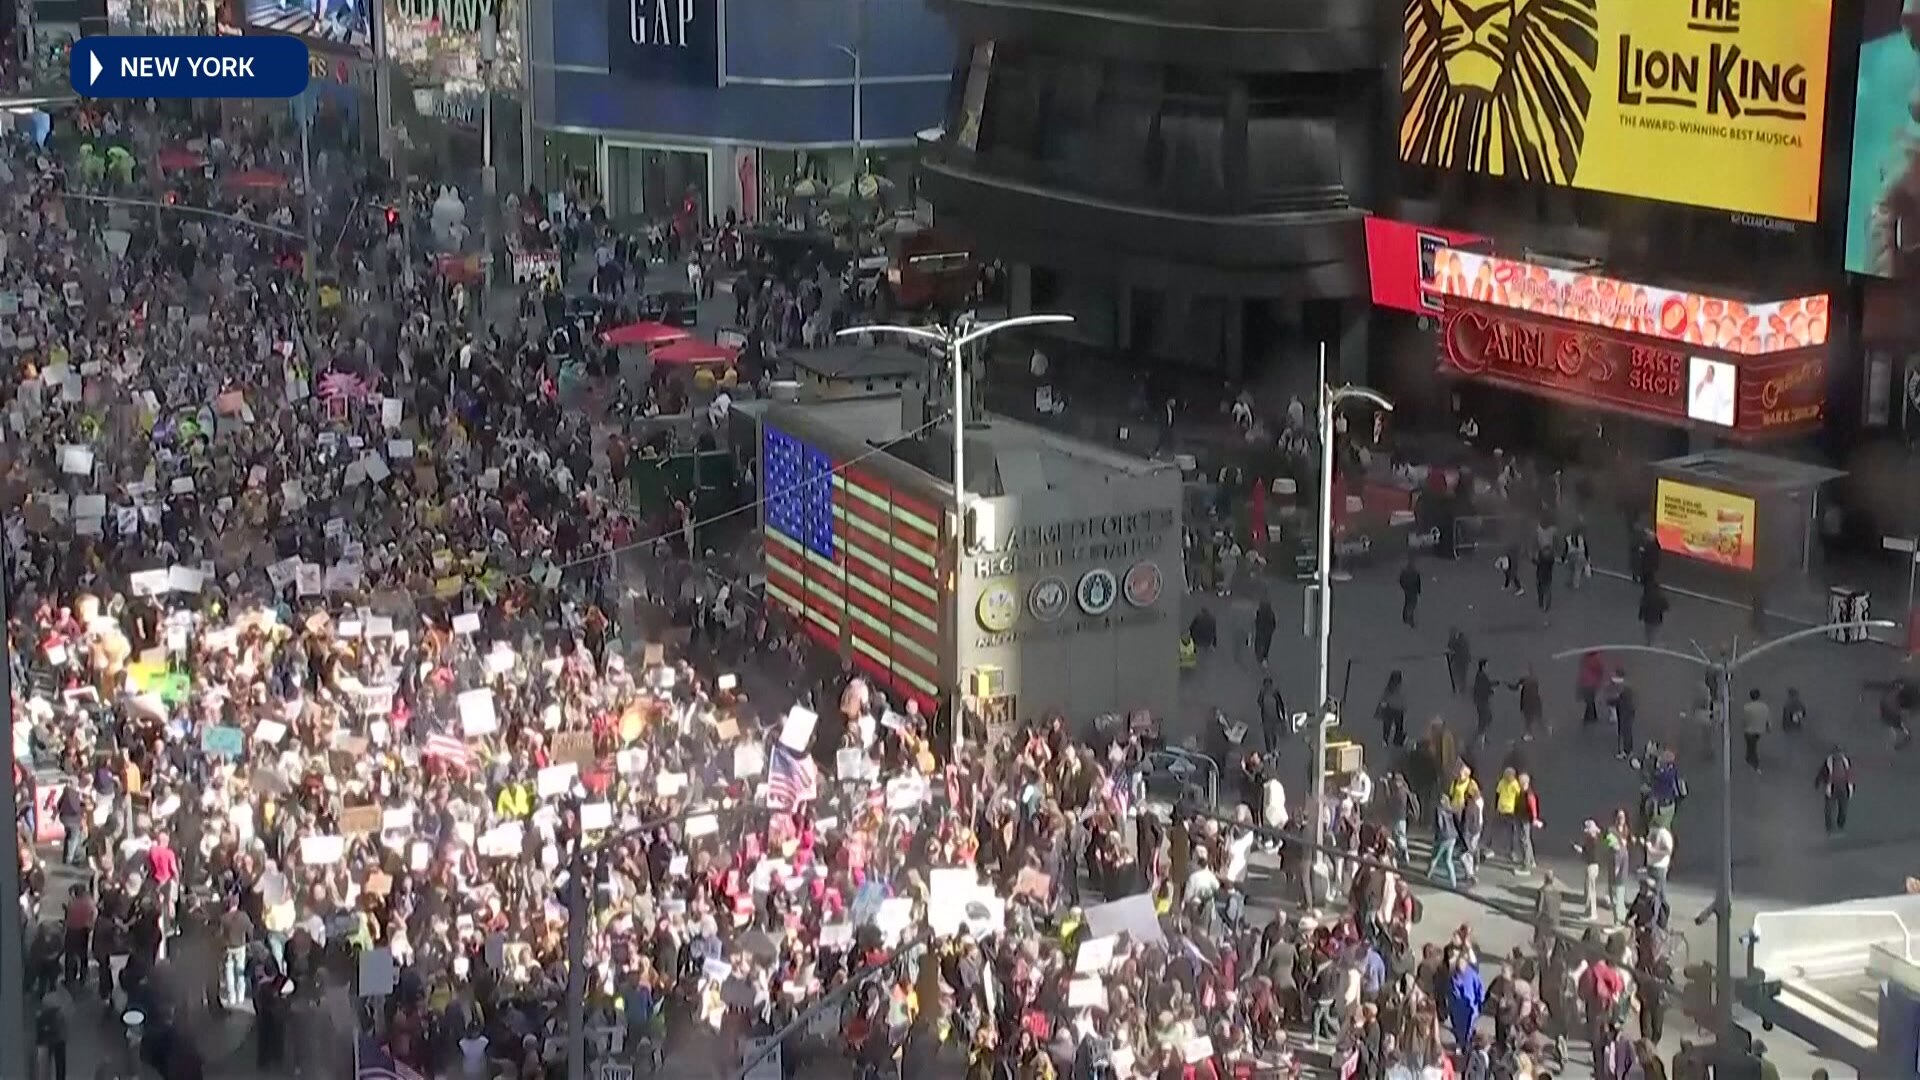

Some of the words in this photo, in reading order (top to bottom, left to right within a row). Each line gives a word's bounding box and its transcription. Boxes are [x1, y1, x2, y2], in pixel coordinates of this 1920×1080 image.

[630, 0, 694, 47] GAP
[1690, 0, 1740, 21] THE
[1618, 34, 1699, 105] LION
[1707, 43, 1807, 119] KING
[1619, 114, 1637, 128] THE
[1639, 118, 1727, 139] AWARD-WINNING
[1729, 128, 1753, 142] BEST
[1756, 132, 1803, 148] MUSICAL
[1631, 346, 1681, 374] BAKE
[1629, 369, 1680, 396] SHOP
